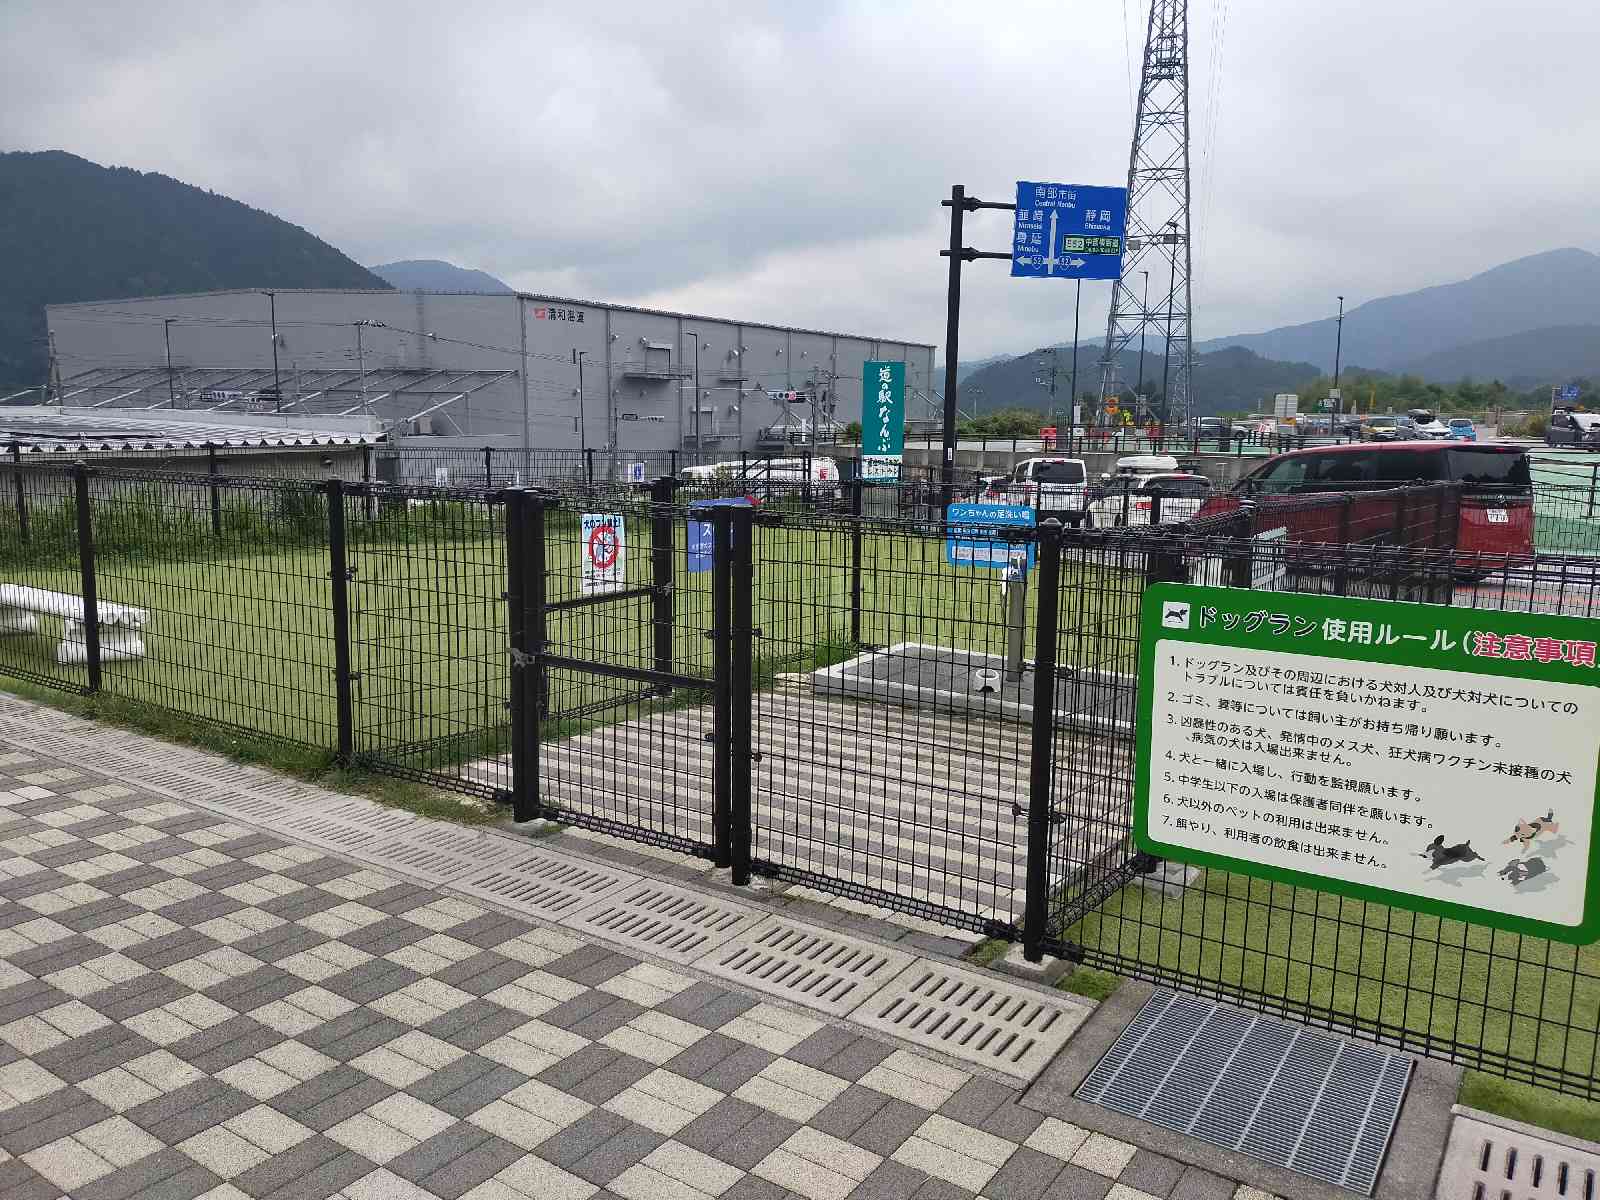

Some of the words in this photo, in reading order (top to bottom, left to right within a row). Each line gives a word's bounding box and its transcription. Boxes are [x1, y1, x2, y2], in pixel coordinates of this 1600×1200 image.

[1085, 209, 1111, 222] 静岡
[876, 365, 894, 452] 道の駅なんぶ
